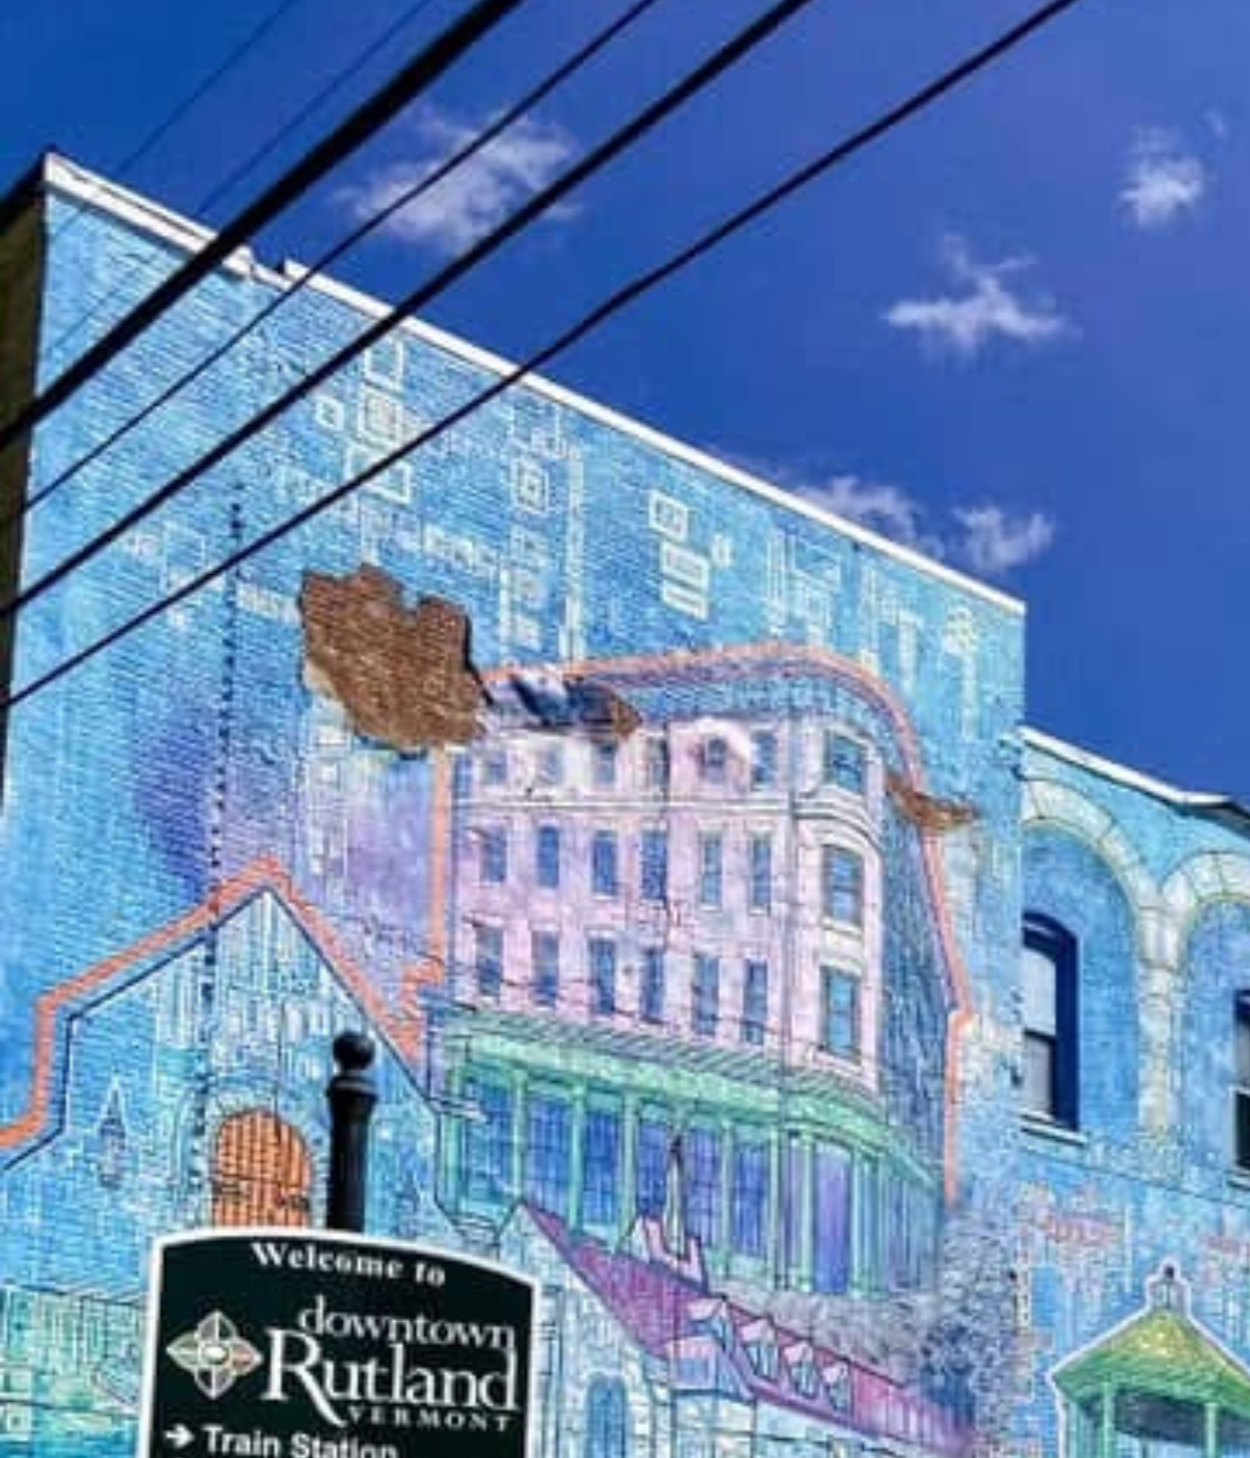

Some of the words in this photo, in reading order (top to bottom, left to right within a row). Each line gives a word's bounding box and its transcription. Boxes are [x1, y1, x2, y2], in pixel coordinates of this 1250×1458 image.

[253, 1243, 402, 1278] Welcome
[416, 1263, 445, 1285] to
[298, 1295, 515, 1351] downtown
[261, 1327, 517, 1427] Rutland
[350, 1406, 508, 1431] VERMONT
[203, 1425, 281, 1458] Train
